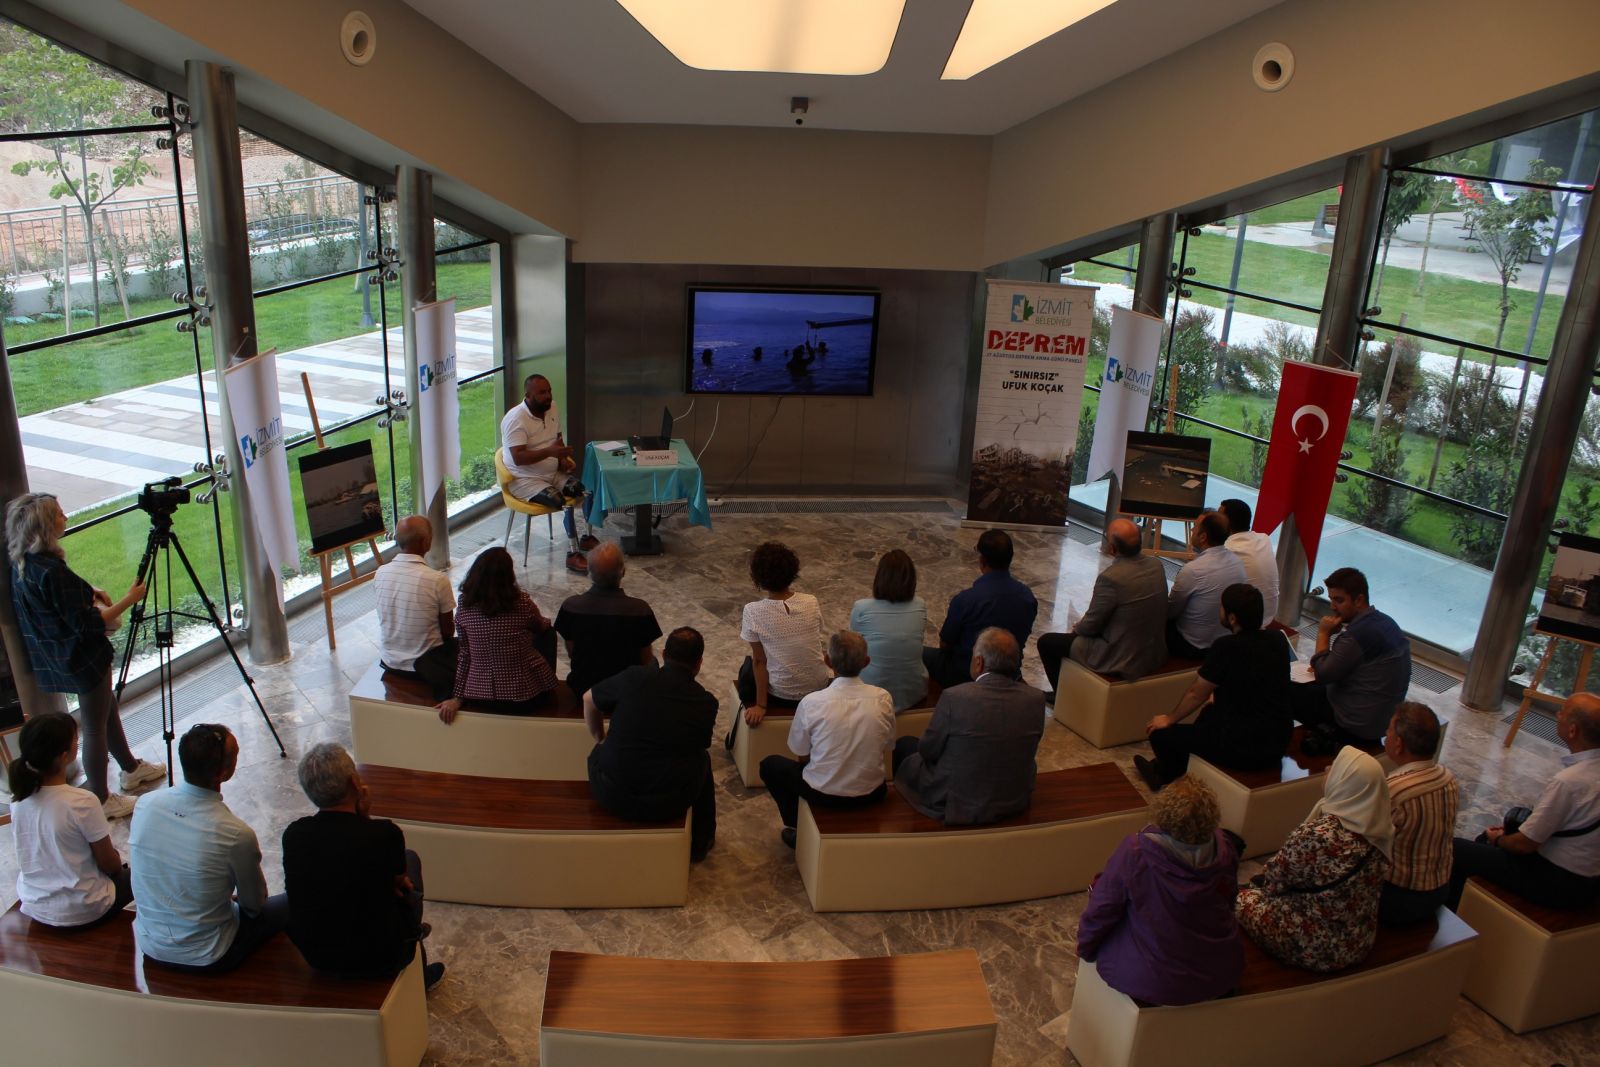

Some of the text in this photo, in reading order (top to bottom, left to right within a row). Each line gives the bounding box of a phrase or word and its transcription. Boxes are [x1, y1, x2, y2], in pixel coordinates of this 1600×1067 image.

[1036, 296, 1072, 316] İZMİT
[987, 330, 1085, 356] DEPREM
[1002, 381, 1064, 394] UFUK KOÇAK
